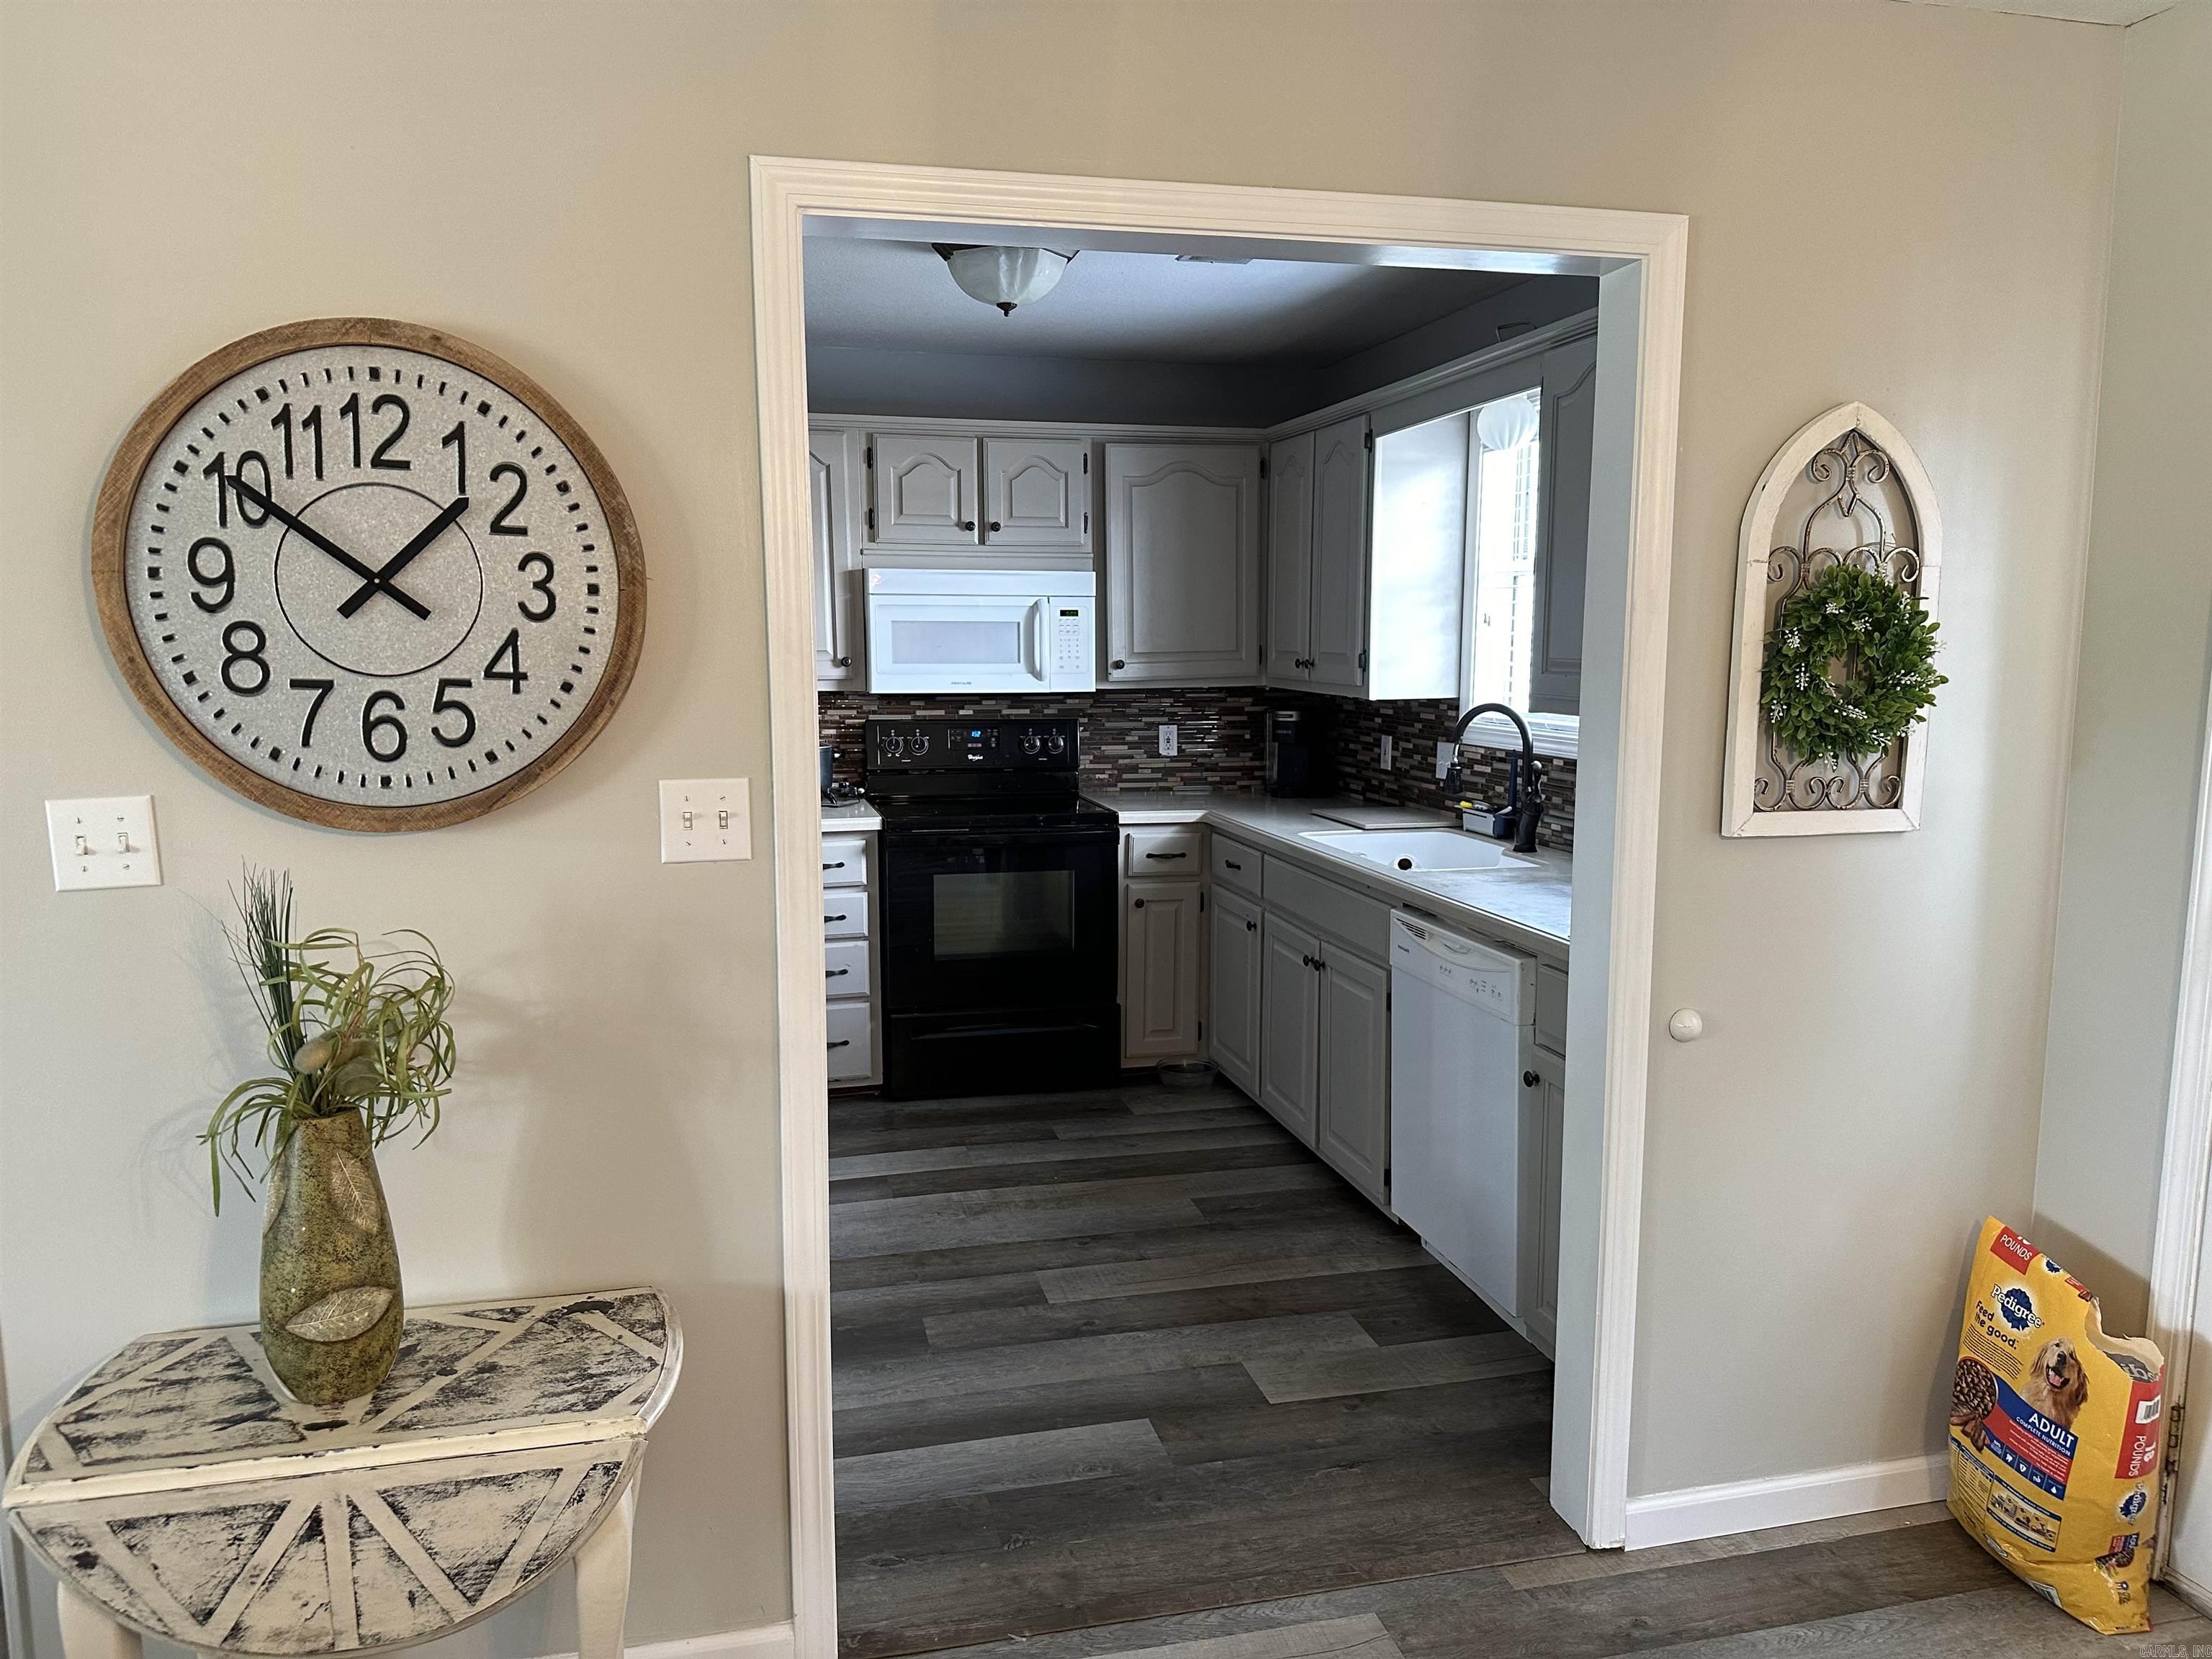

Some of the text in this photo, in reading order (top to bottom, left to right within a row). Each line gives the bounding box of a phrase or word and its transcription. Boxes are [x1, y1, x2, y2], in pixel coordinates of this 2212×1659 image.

[271, 403, 323, 480] 11
[340, 392, 412, 470] 12
[441, 421, 467, 495] 1
[202, 451, 273, 529] 10
[489, 462, 529, 536] 2
[187, 538, 235, 613] 9
[517, 552, 557, 622] 3
[220, 620, 271, 696] 8
[483, 629, 529, 694] 4
[289, 679, 335, 747] 7
[361, 691, 409, 762] 6
[431, 678, 477, 747] 5
[2000, 1234, 2033, 1261] POUNDS
[1974, 1313, 1986, 1327] the
[1976, 1300, 1995, 1321] Feed
[1991, 1283, 2043, 1329] Pedigree
[2016, 1416, 2071, 1457] COMPLETE NUTRITION
[2028, 1413, 2074, 1449] ADULT
[2128, 1435, 2147, 1477] POUNDS
